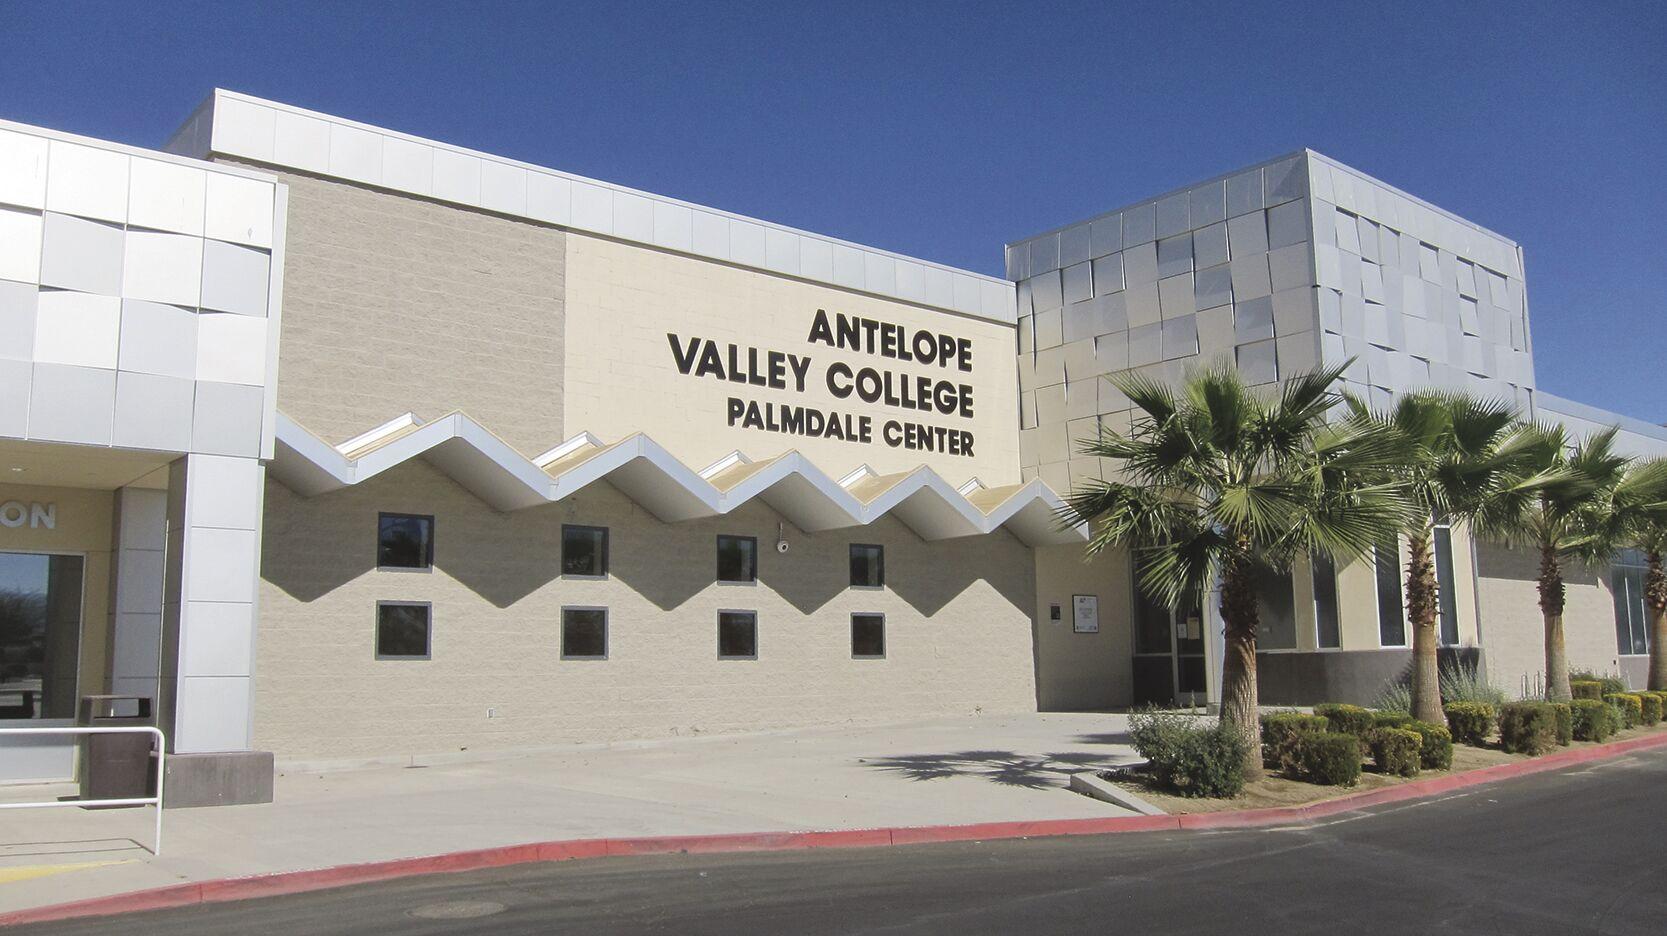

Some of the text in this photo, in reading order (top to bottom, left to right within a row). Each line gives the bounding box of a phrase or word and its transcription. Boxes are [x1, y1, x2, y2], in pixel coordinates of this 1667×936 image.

[808, 308, 973, 373] ANTELOPE
[667, 333, 974, 419] VALLEY COLLEGE
[727, 397, 975, 458] PALMDALE CENTER
[0, 501, 56, 529] ON
